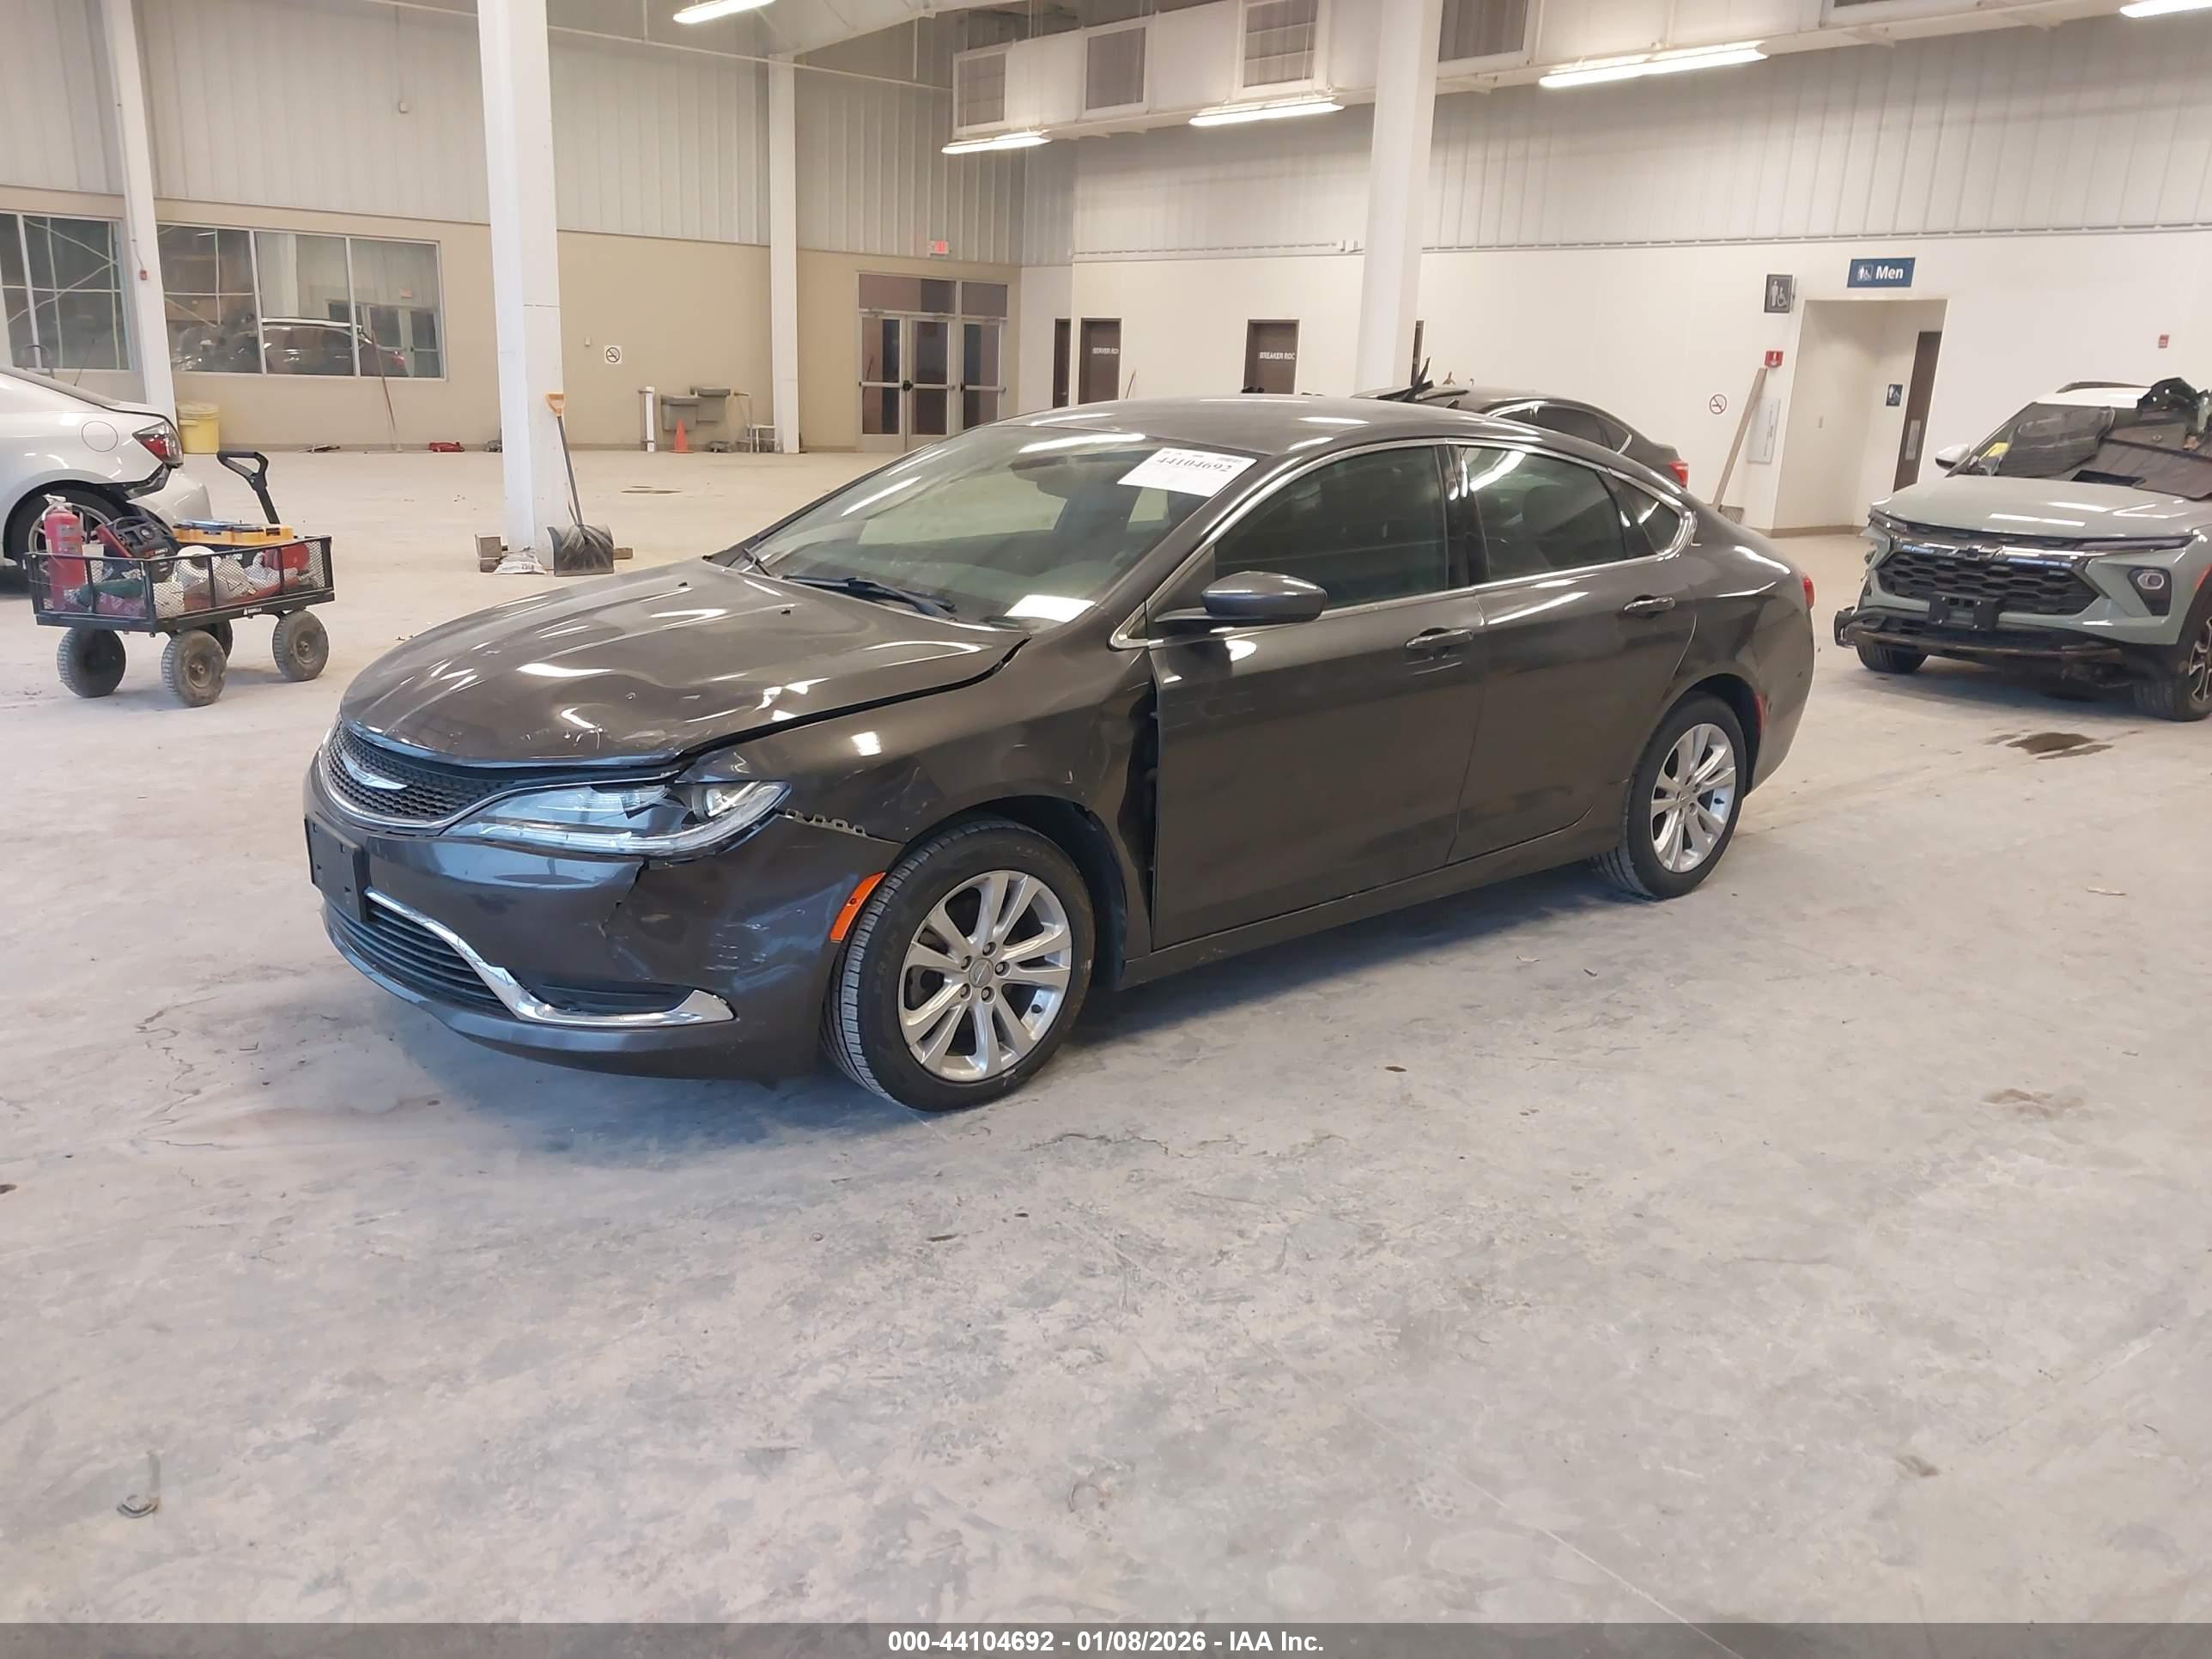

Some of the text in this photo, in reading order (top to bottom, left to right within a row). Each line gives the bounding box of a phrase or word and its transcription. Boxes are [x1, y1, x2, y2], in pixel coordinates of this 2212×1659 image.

[1875, 265, 1904, 280] Men
[1260, 351, 1284, 360] BREAKER
[1156, 457, 1232, 472] 44104692
